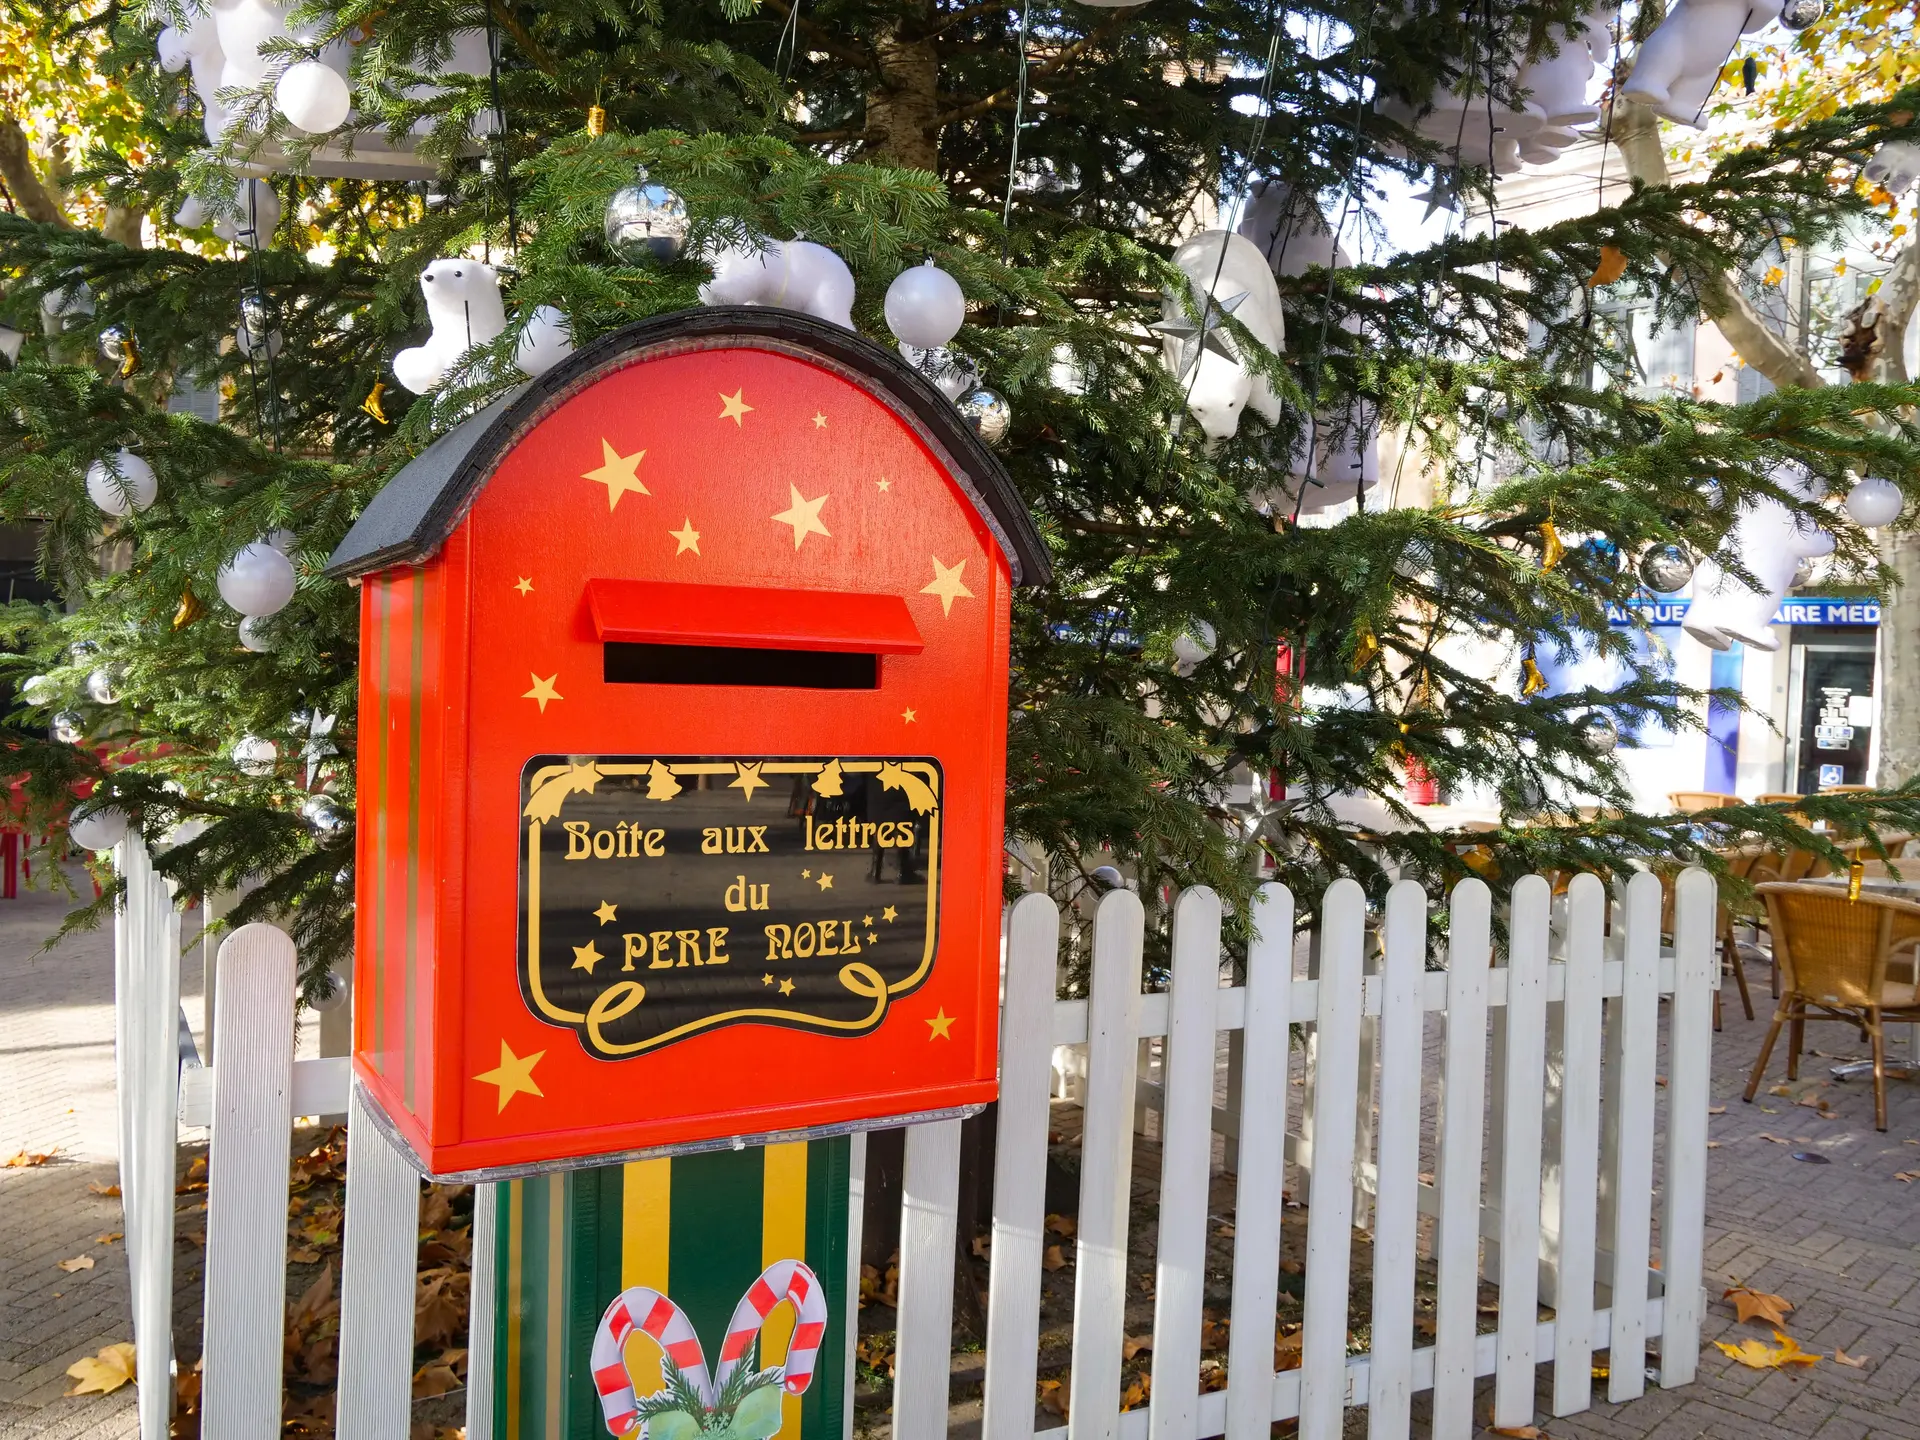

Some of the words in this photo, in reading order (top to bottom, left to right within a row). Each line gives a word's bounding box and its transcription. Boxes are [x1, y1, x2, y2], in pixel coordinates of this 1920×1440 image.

[563, 820, 666, 861] Boîte
[701, 826, 770, 855] aux
[804, 815, 915, 851] lettres
[724, 875, 771, 912] du
[620, 927, 730, 972] PERE
[764, 920, 862, 961] NOEL
